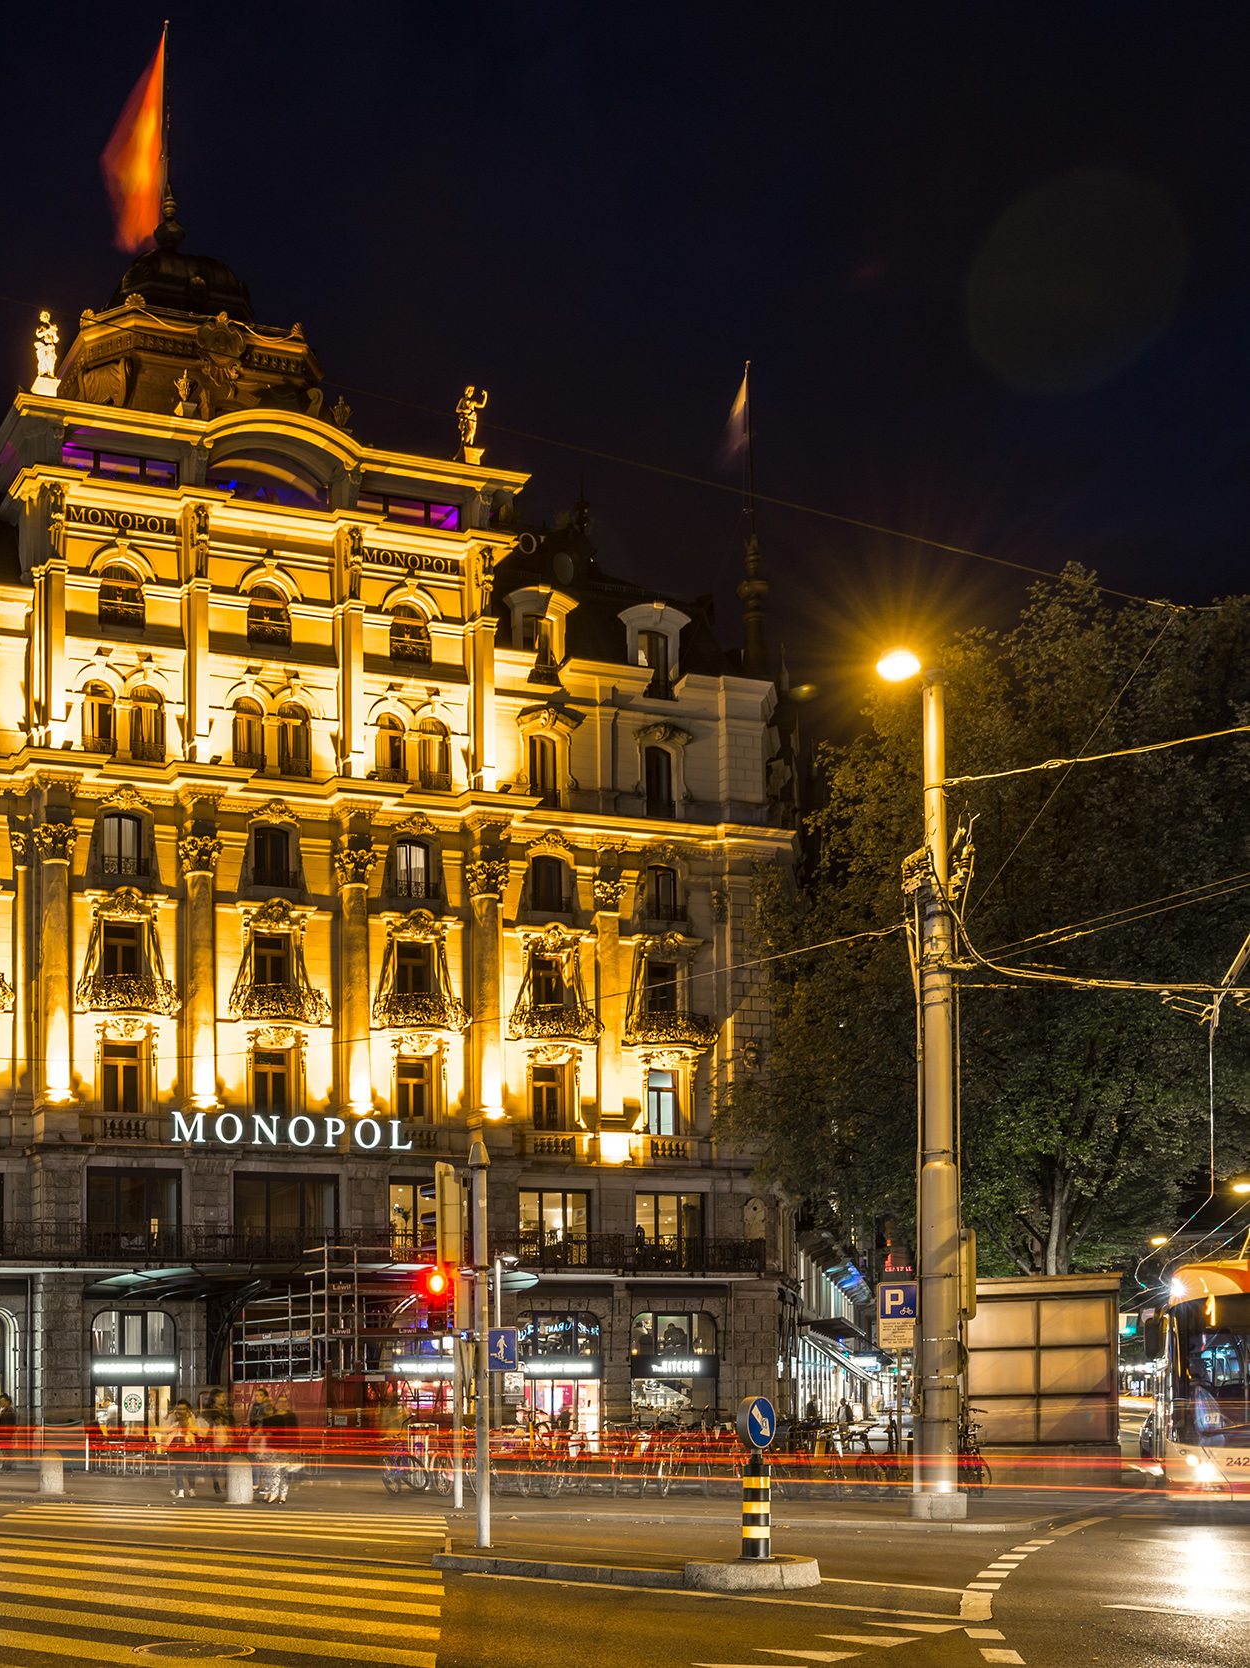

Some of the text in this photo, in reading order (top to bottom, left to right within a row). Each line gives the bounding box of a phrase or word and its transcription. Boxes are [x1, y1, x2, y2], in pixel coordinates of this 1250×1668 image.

[69, 505, 174, 535] MONOPOL
[363, 547, 458, 575] MONOPOL
[171, 1111, 413, 1150] MONOPOL
[885, 1289, 904, 1315] P
